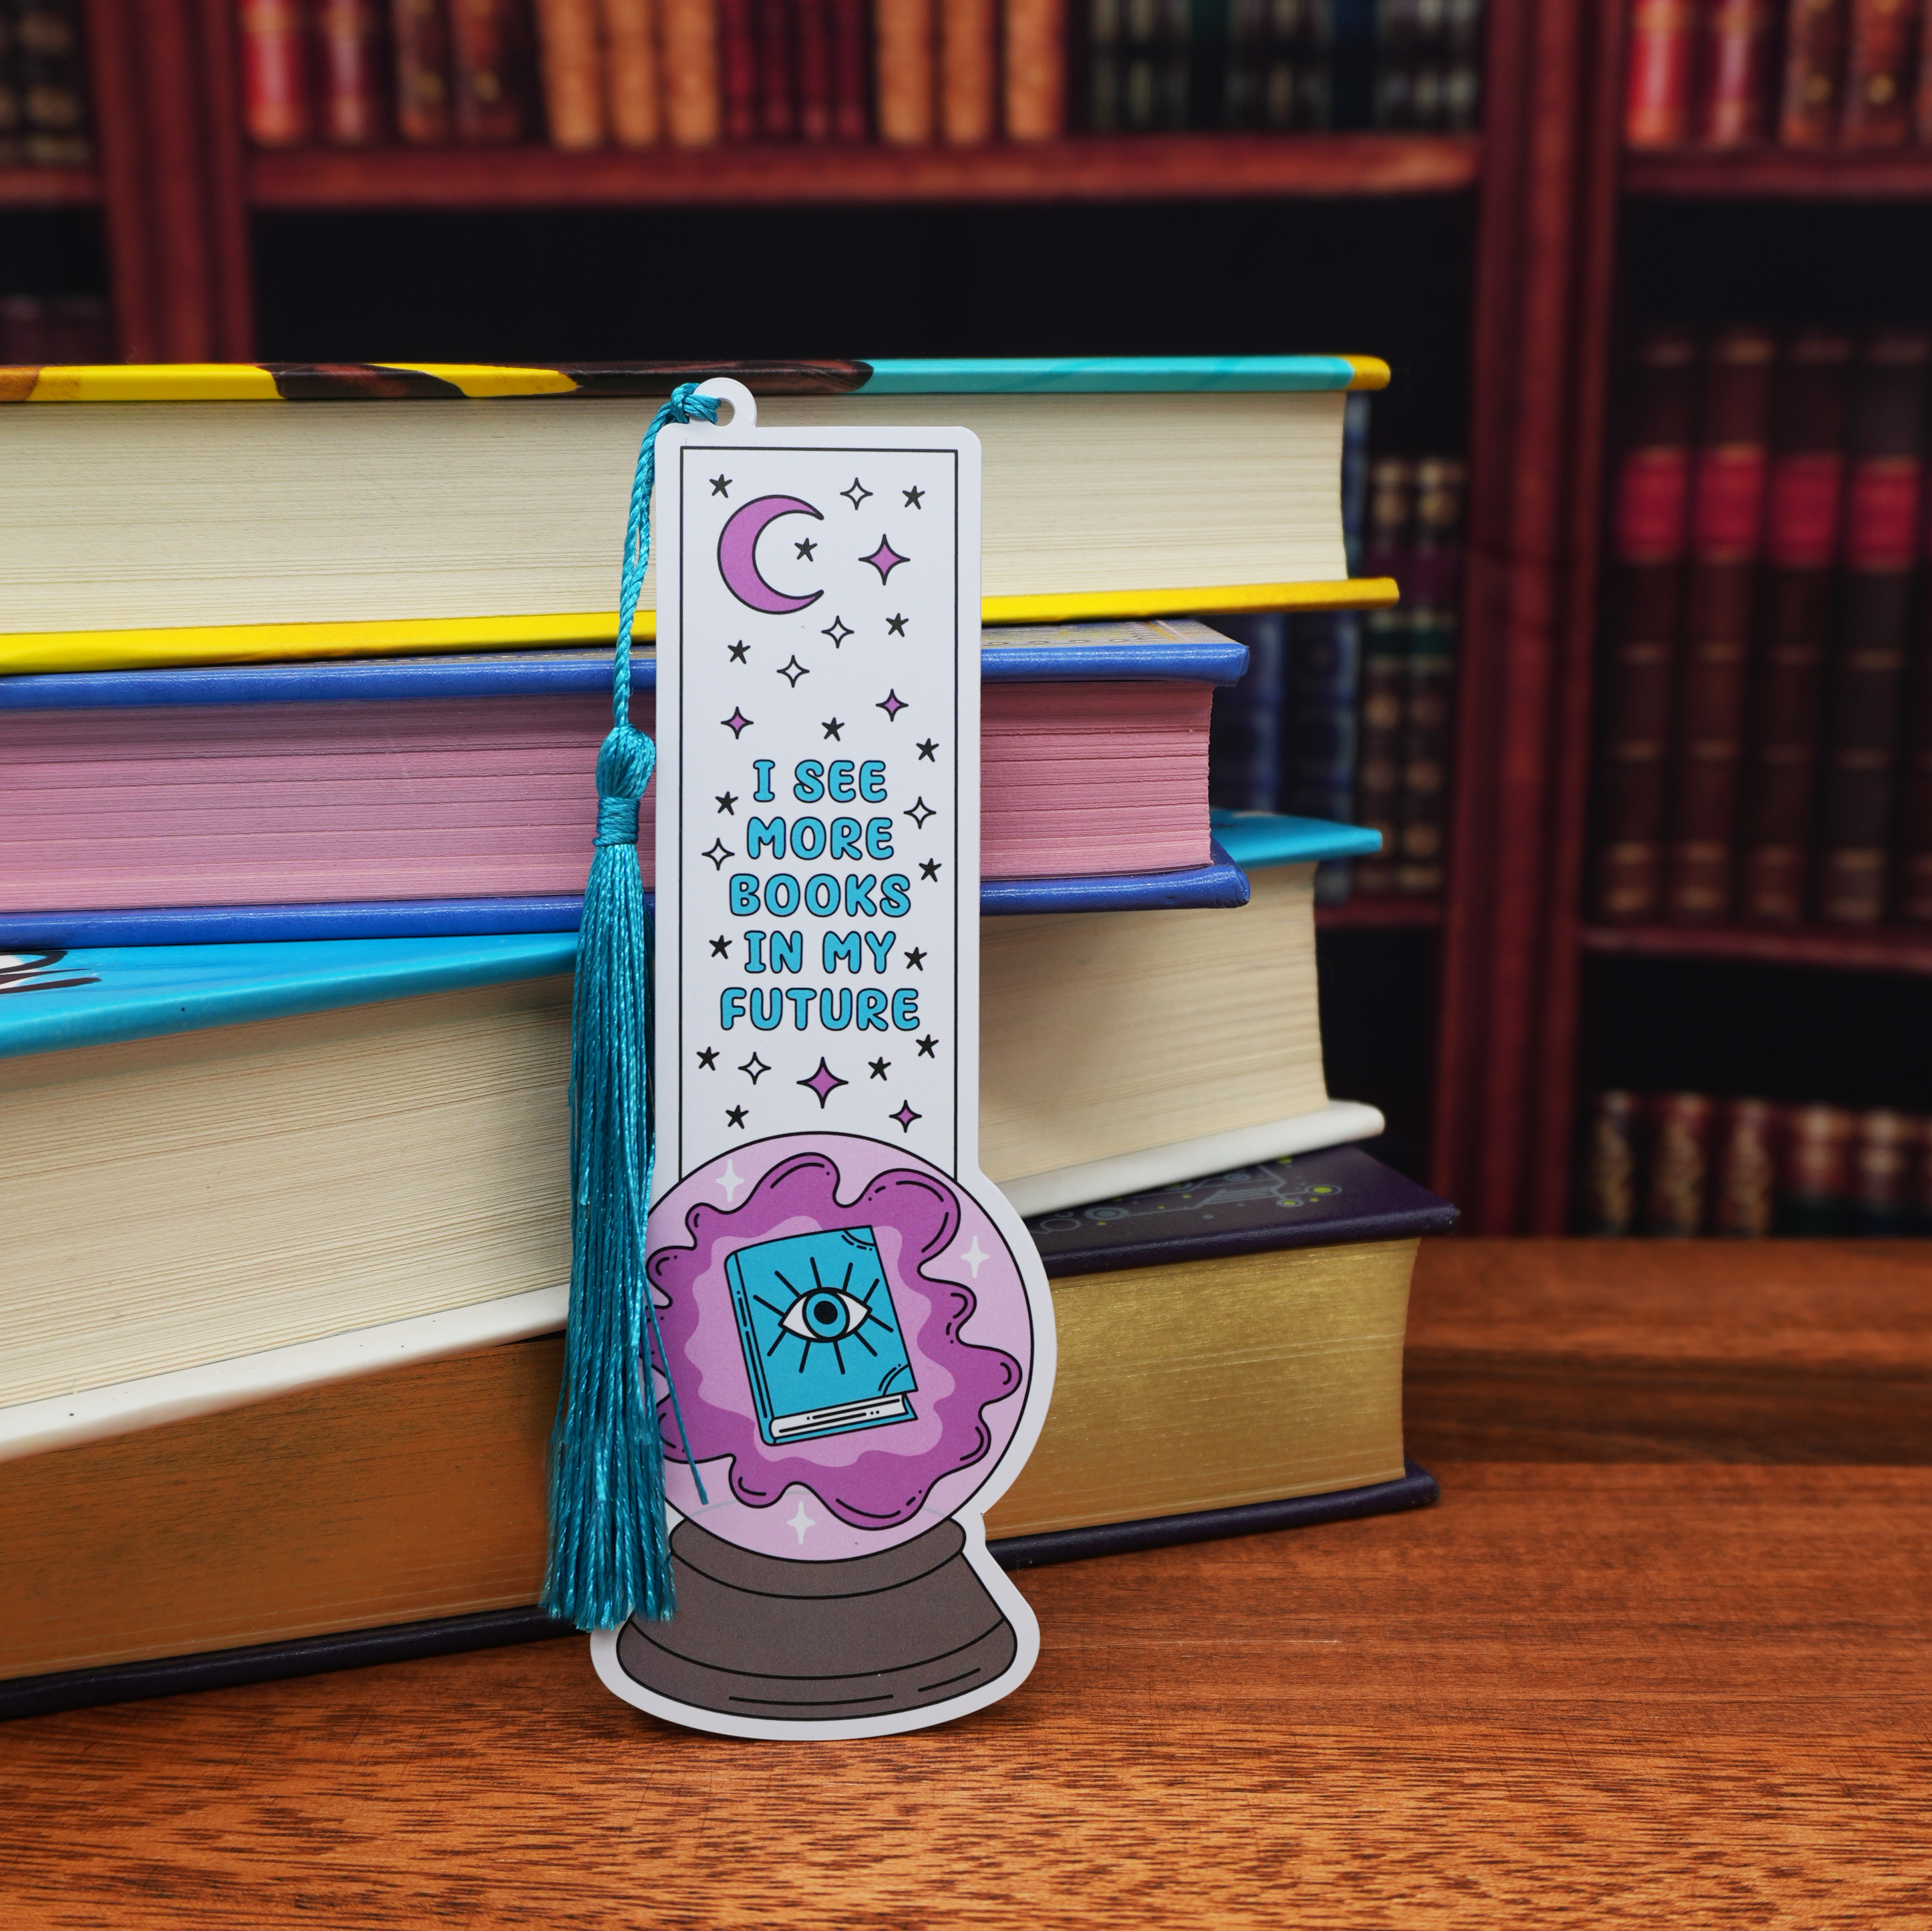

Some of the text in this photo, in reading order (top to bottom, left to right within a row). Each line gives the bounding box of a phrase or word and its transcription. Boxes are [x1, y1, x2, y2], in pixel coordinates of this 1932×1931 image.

[753, 759, 887, 803] I SEE
[747, 816, 895, 860] MORE
[730, 873, 911, 917] BOOKS
[744, 930, 897, 974] IN MY
[720, 987, 920, 1031] FUTURE
